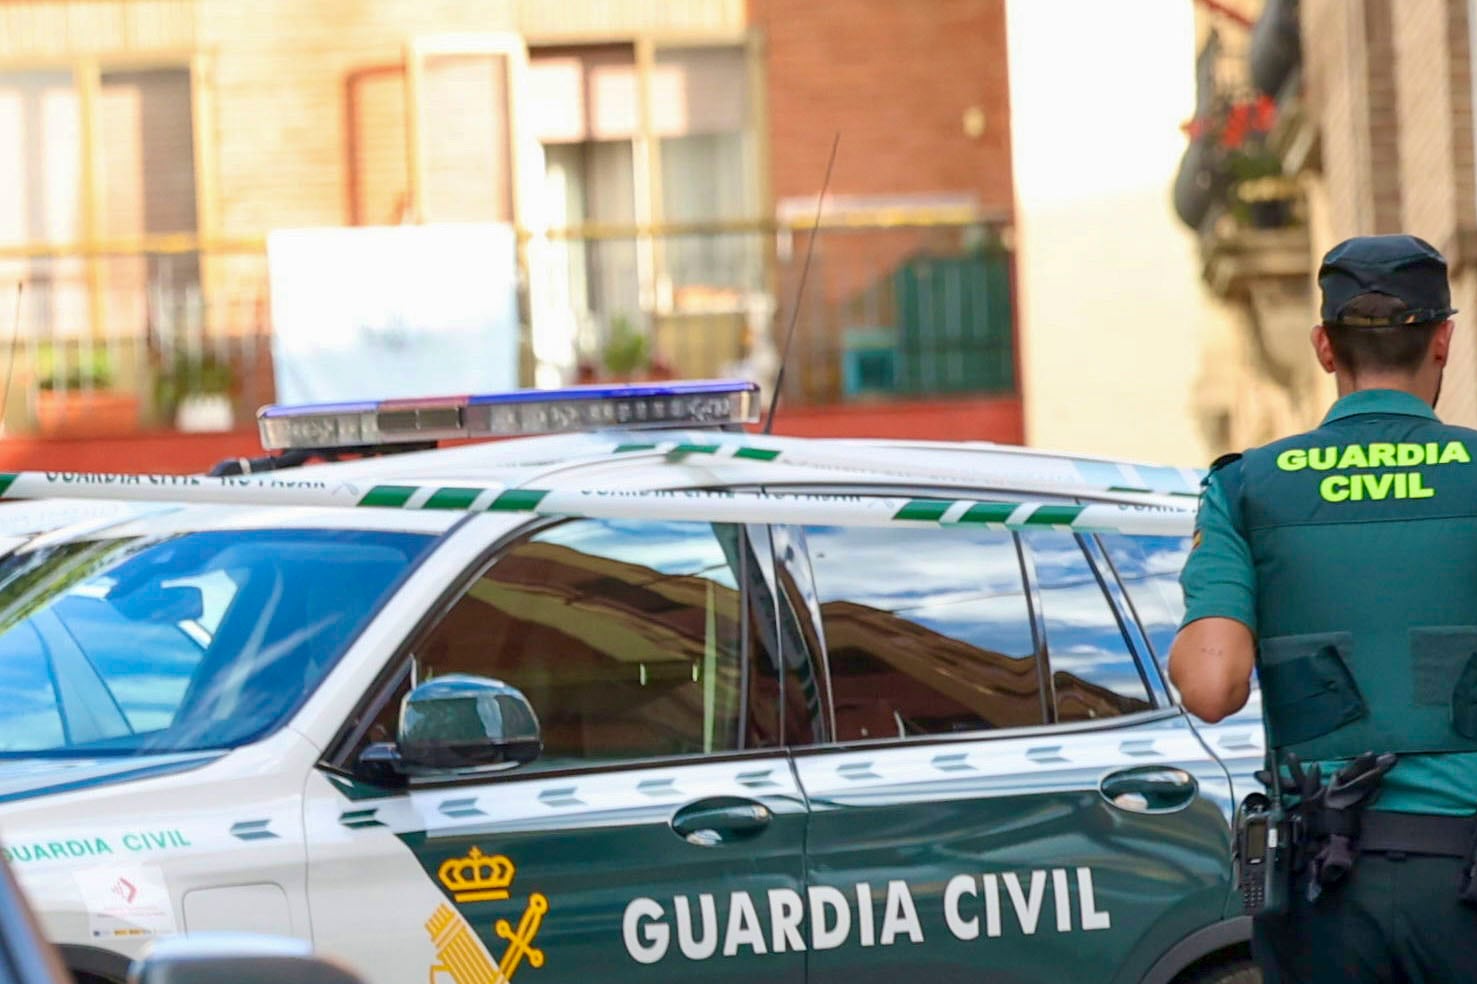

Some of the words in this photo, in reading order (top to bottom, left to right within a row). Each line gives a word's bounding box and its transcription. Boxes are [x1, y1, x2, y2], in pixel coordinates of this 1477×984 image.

[1277, 441, 1470, 471] GUARDIA
[1320, 472, 1435, 502] CIVIL
[123, 829, 192, 852] CIVIL
[622, 880, 925, 964] GUARDIA
[944, 867, 1111, 940] CIVIL
